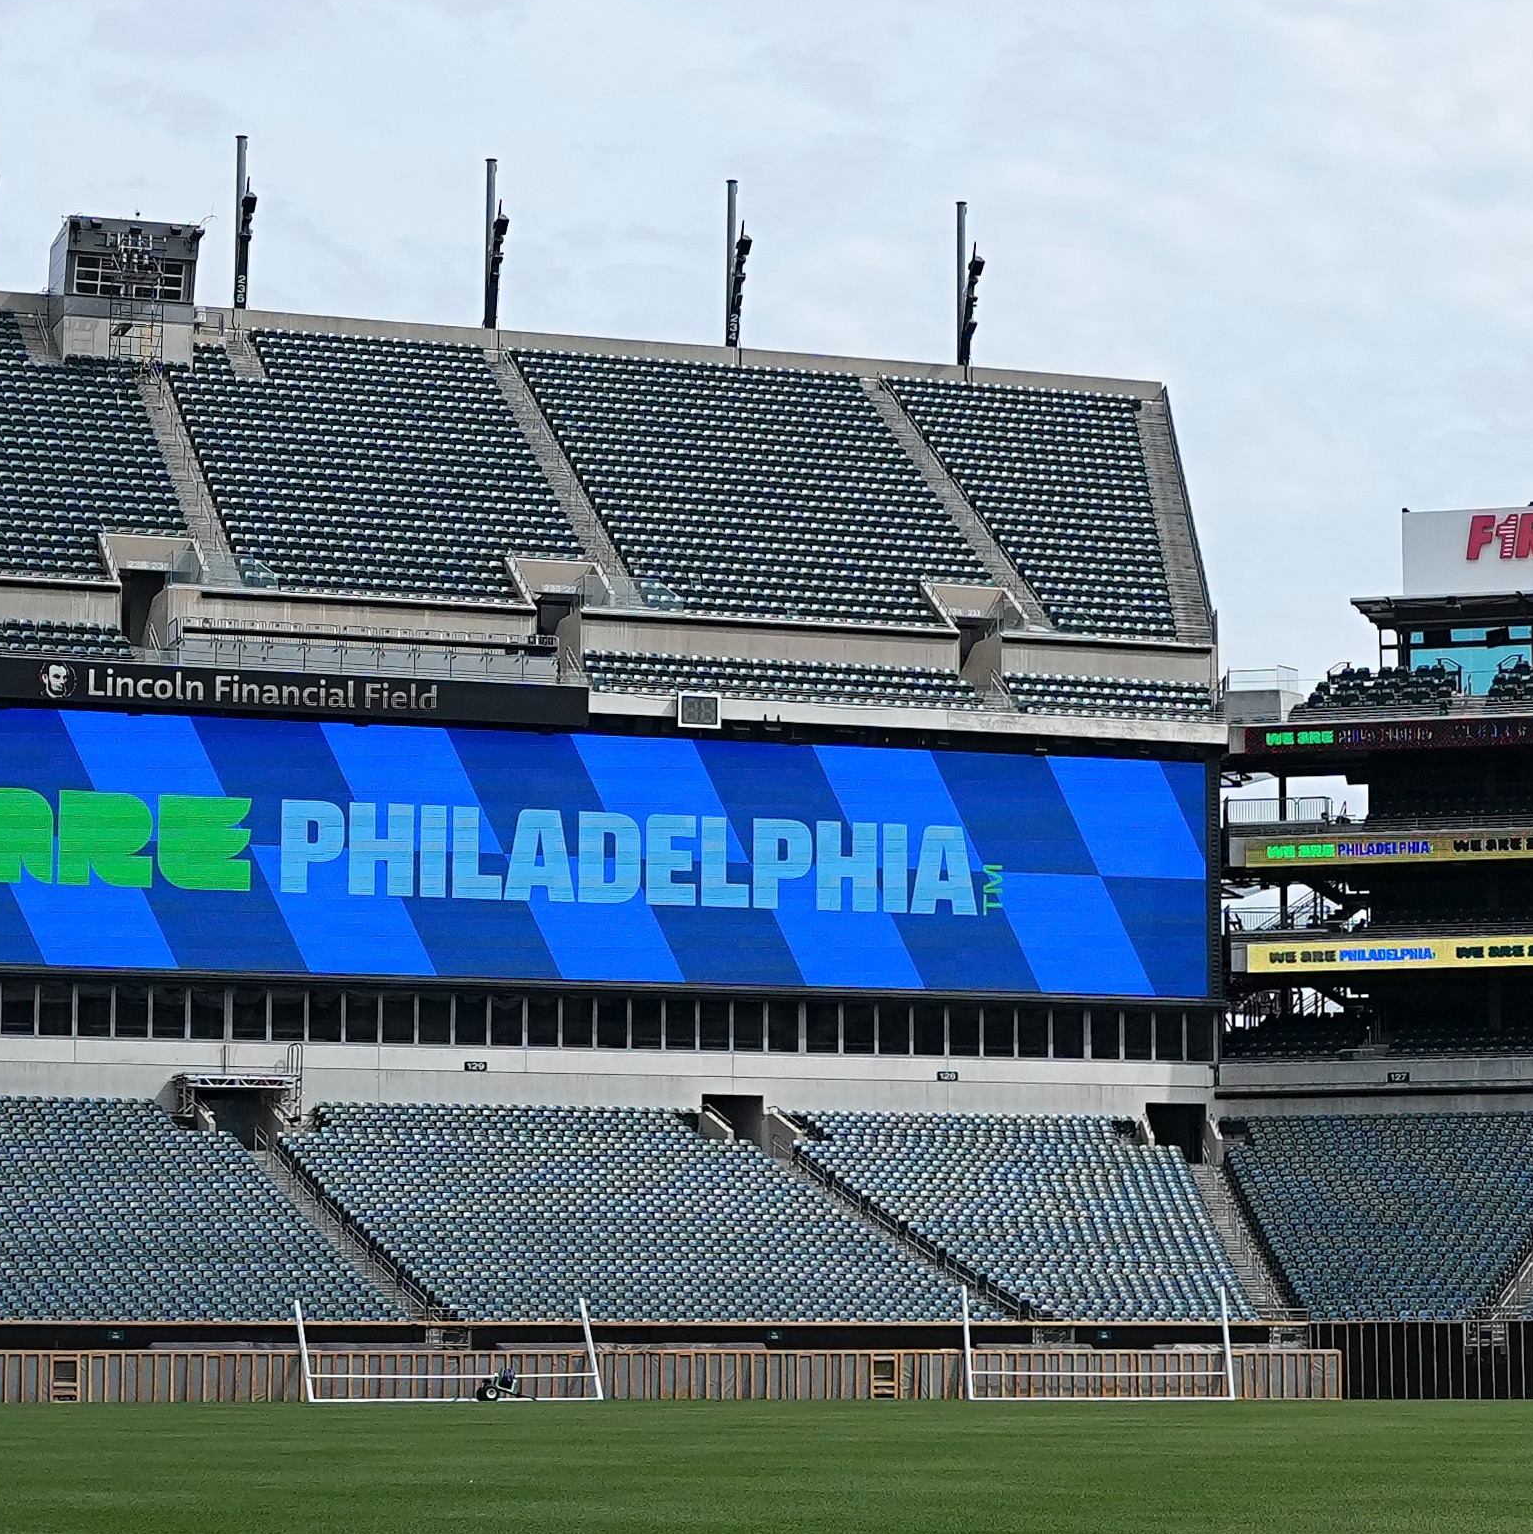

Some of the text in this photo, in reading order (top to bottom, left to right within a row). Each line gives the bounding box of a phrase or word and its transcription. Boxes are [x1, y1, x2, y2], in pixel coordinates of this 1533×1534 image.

[88, 668, 438, 710] Lincoln Financial Field
[1266, 731, 1295, 746] WE
[1338, 840, 1430, 857] PHILADELPHIA
[280, 799, 978, 916] PHILADELPHIA
[983, 865, 1003, 916] TM
[1269, 950, 1297, 963] WE
[1339, 946, 1432, 963] PHILADELPHIA
[1390, 1073, 1407, 1081] 127
